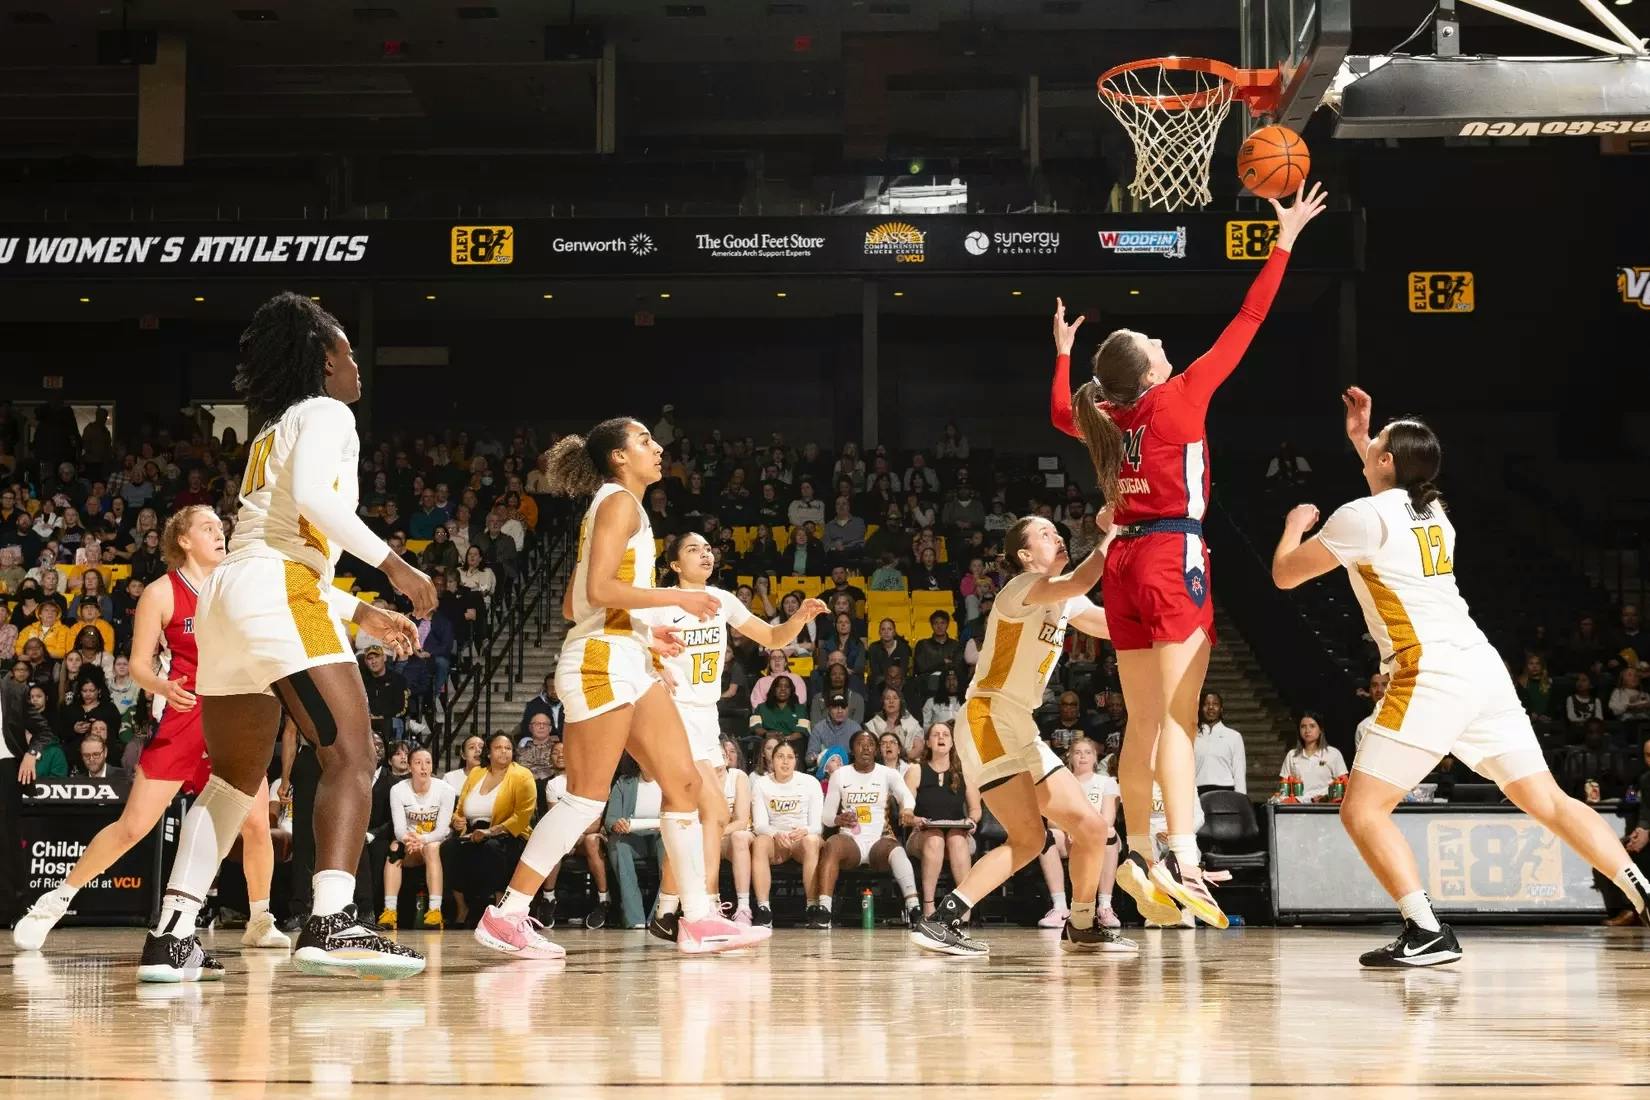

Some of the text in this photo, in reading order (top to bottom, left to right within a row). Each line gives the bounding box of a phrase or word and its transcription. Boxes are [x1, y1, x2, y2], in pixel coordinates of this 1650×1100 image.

[456, 229, 469, 263] ELEV
[470, 228, 494, 263] 8
[552, 238, 627, 253] Genworth
[695, 233, 824, 249] The Good Feet Store
[864, 231, 927, 244] MASSEY
[994, 231, 1060, 247] synergy
[1101, 232, 1175, 247] WOODFIN
[1231, 223, 1243, 257] ELEV
[1246, 223, 1270, 258] 8
[26, 236, 185, 264] WOMEN'S
[189, 235, 369, 263] ATHLETICS
[711, 250, 811, 259] America's Arch Support Experts
[904, 254, 925, 263] VCU
[997, 246, 1057, 254] technical
[1414, 274, 1426, 310] ELEV
[1429, 274, 1454, 310] 8
[243, 429, 275, 498] 11
[1409, 524, 1453, 577] 12
[684, 626, 721, 647] RAMS
[690, 651, 720, 685] 13
[22, 783, 120, 800] ONDA
[846, 791, 879, 804] RAMS
[408, 810, 439, 822] RAMS
[31, 841, 87, 858] Childr
[1439, 824, 1465, 897] ELEV
[1470, 824, 1522, 897] 8
[29, 878, 42, 889] of
[101, 878, 112, 889] at
[113, 877, 142, 889] VCU
